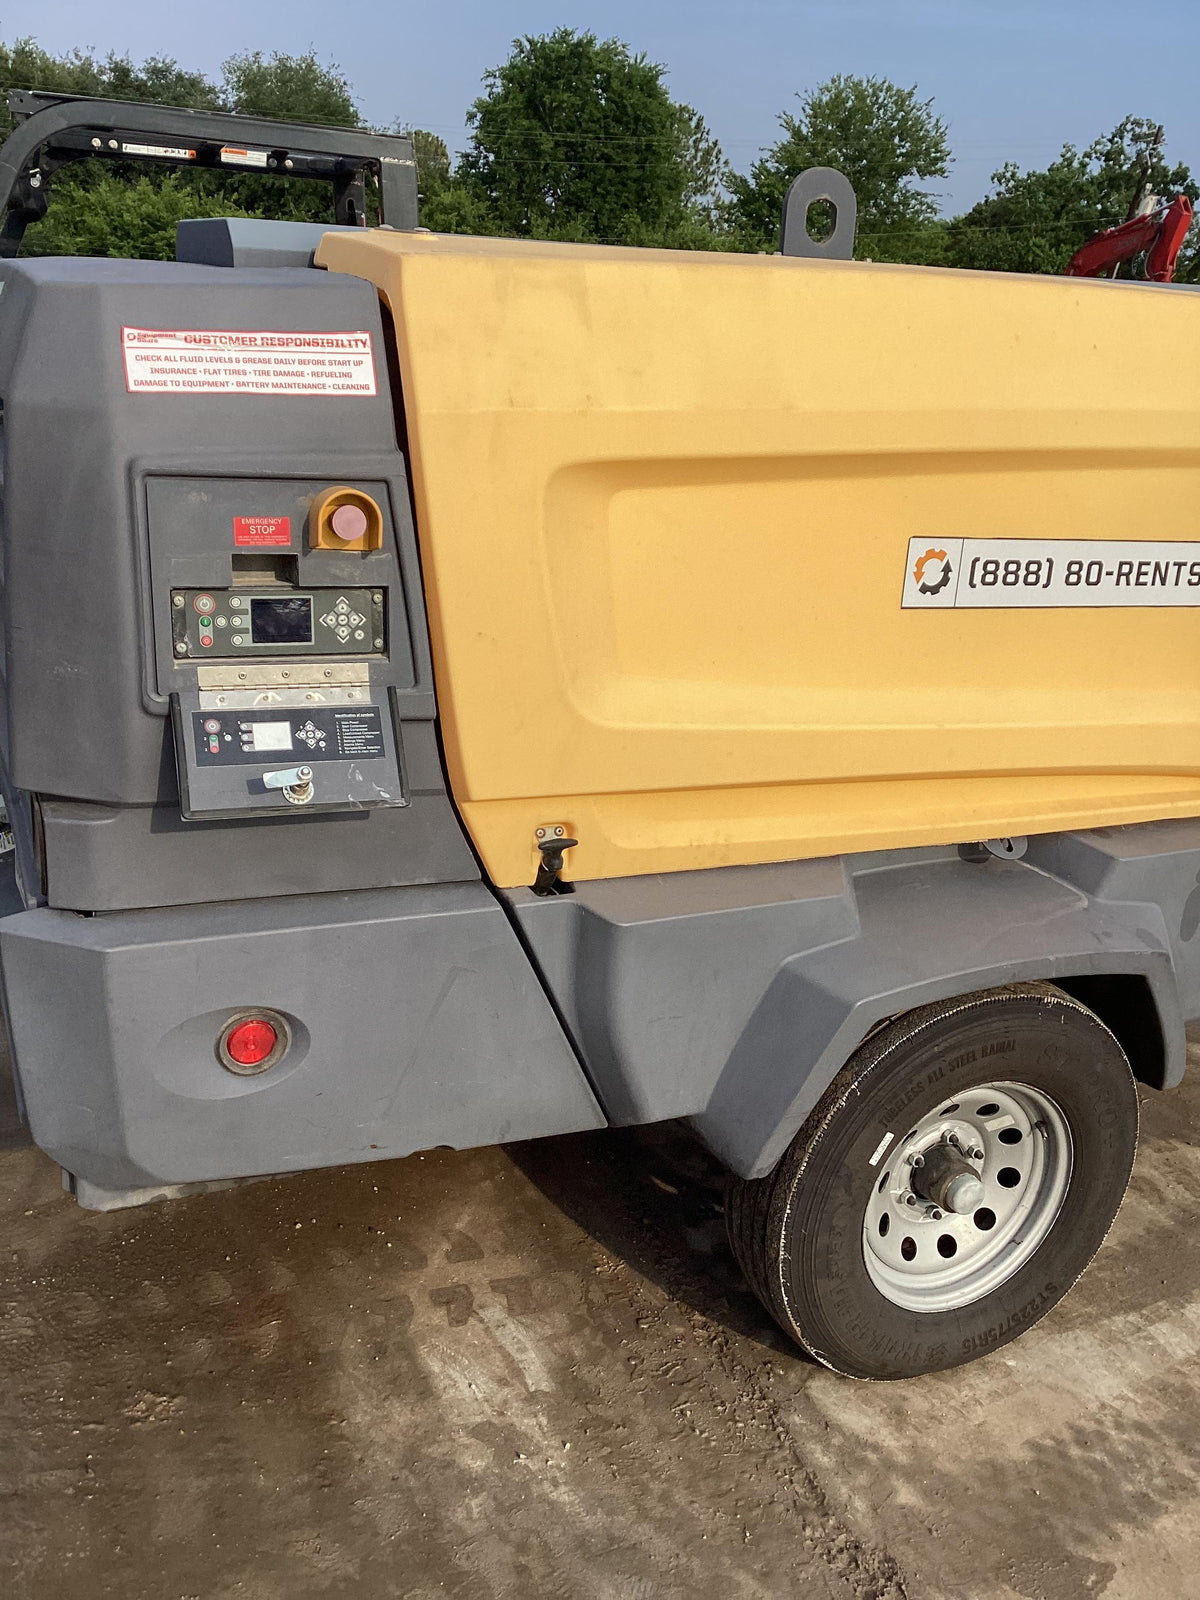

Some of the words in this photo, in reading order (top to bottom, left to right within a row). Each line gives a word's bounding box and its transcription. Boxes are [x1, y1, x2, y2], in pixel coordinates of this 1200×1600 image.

[184, 335, 258, 346] CUSTOMER
[261, 336, 367, 348] RESPONSIBILITY
[135, 354, 162, 362] CHECK
[180, 355, 204, 363] FLUID
[274, 358, 295, 366] DAILY
[297, 358, 326, 366] BEFORE
[150, 367, 197, 375] INSURANCE
[223, 368, 247, 376] TIRES
[236, 381, 270, 389] BATTERY
[249, 525, 276, 534] STOP
[968, 556, 1055, 588] (888)
[947, 1051, 978, 1073] STEEL
